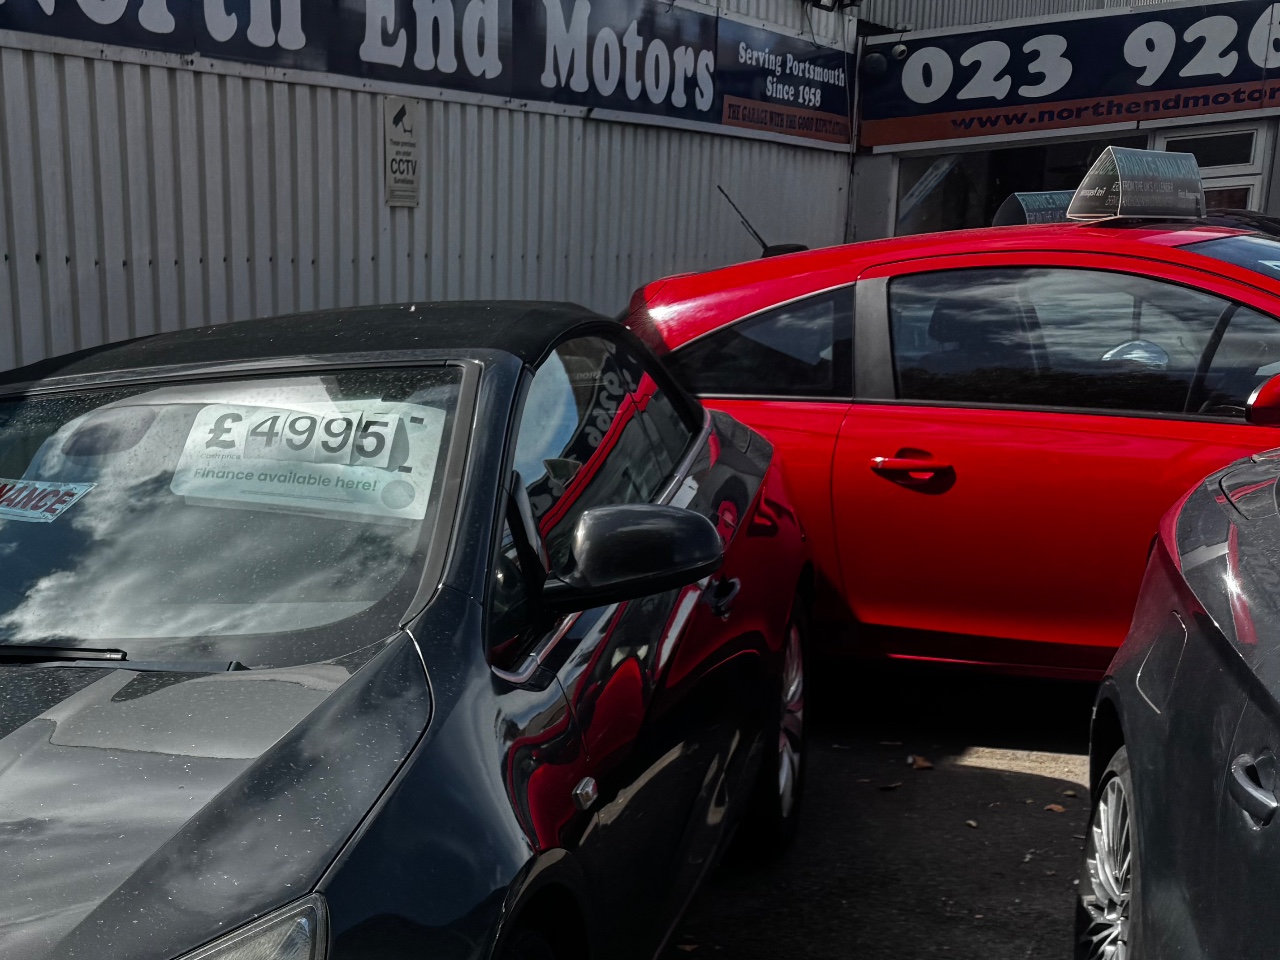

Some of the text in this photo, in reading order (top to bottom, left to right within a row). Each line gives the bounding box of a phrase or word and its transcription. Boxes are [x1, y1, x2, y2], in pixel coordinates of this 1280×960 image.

[359, 0, 503, 79] End
[540, 0, 715, 112] Motors
[738, 41, 845, 87] Serving Portsmouth
[901, 34, 1073, 104] 023
[765, 75, 822, 107] Since 1958
[727, 103, 741, 120] THE
[742, 105, 768, 125] GARAGE
[769, 110, 785, 128] WITH
[390, 158, 417, 176] CCTV
[194, 467, 380, 492] Finance available here!
